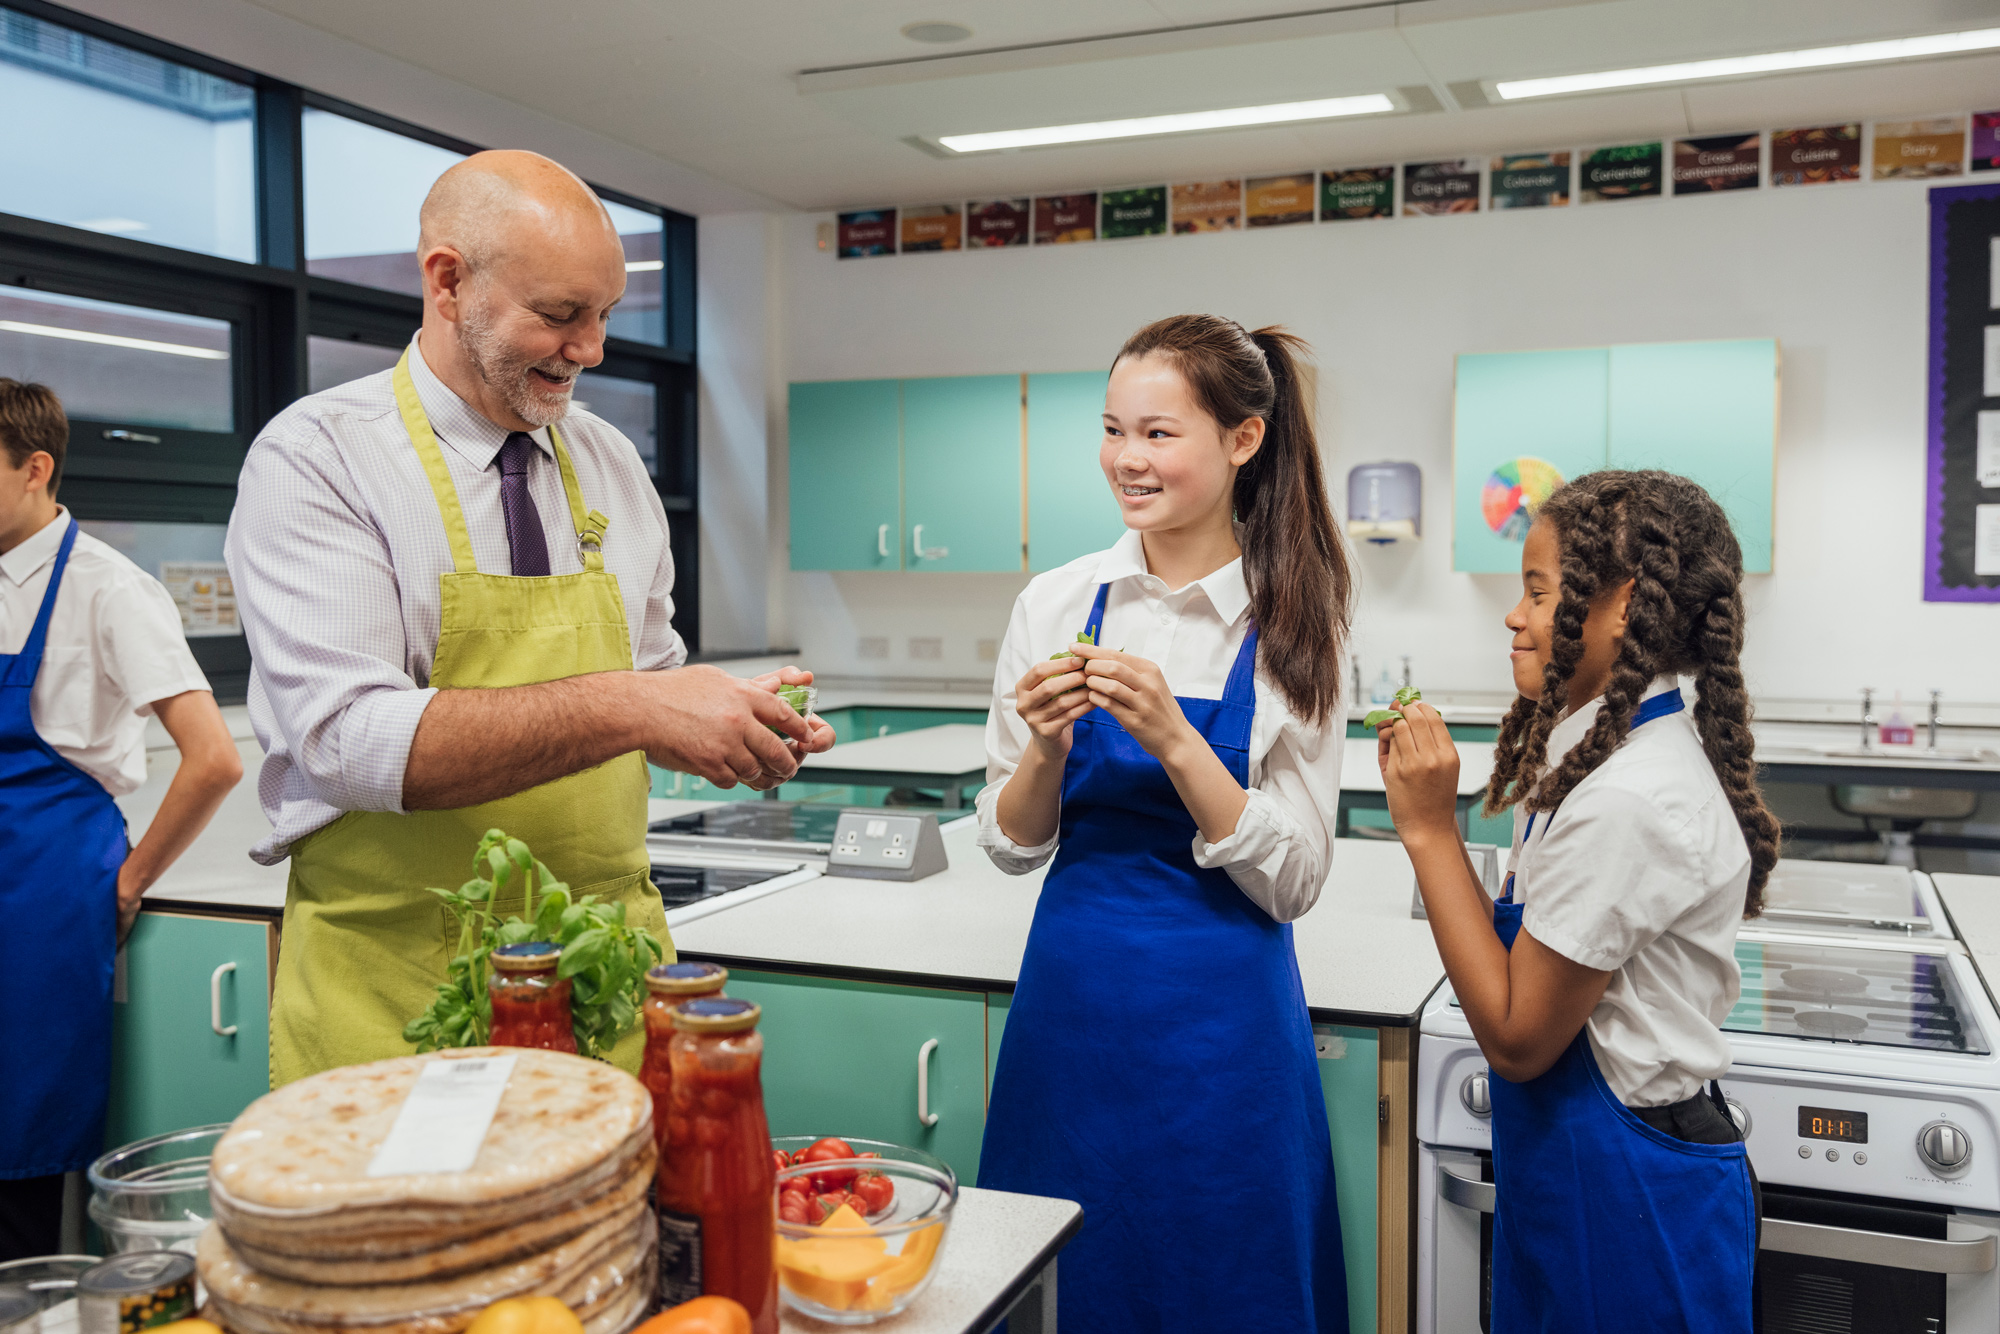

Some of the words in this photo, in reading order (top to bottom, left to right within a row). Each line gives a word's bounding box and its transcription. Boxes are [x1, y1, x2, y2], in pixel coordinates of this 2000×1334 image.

[1791, 148, 1840, 164] Cuisine
[1900, 142, 1939, 158] Dairy
[1698, 151, 1735, 166] Cross
[1590, 164, 1653, 183] Coriander
[1672, 161, 1758, 181] Contamination
[1328, 181, 1386, 197] Chopping
[1411, 182, 1445, 198] Cling
[1446, 178, 1472, 192] Film
[1503, 174, 1557, 189] Colander
[1338, 194, 1375, 208] board
[1113, 206, 1154, 220] Broccoli
